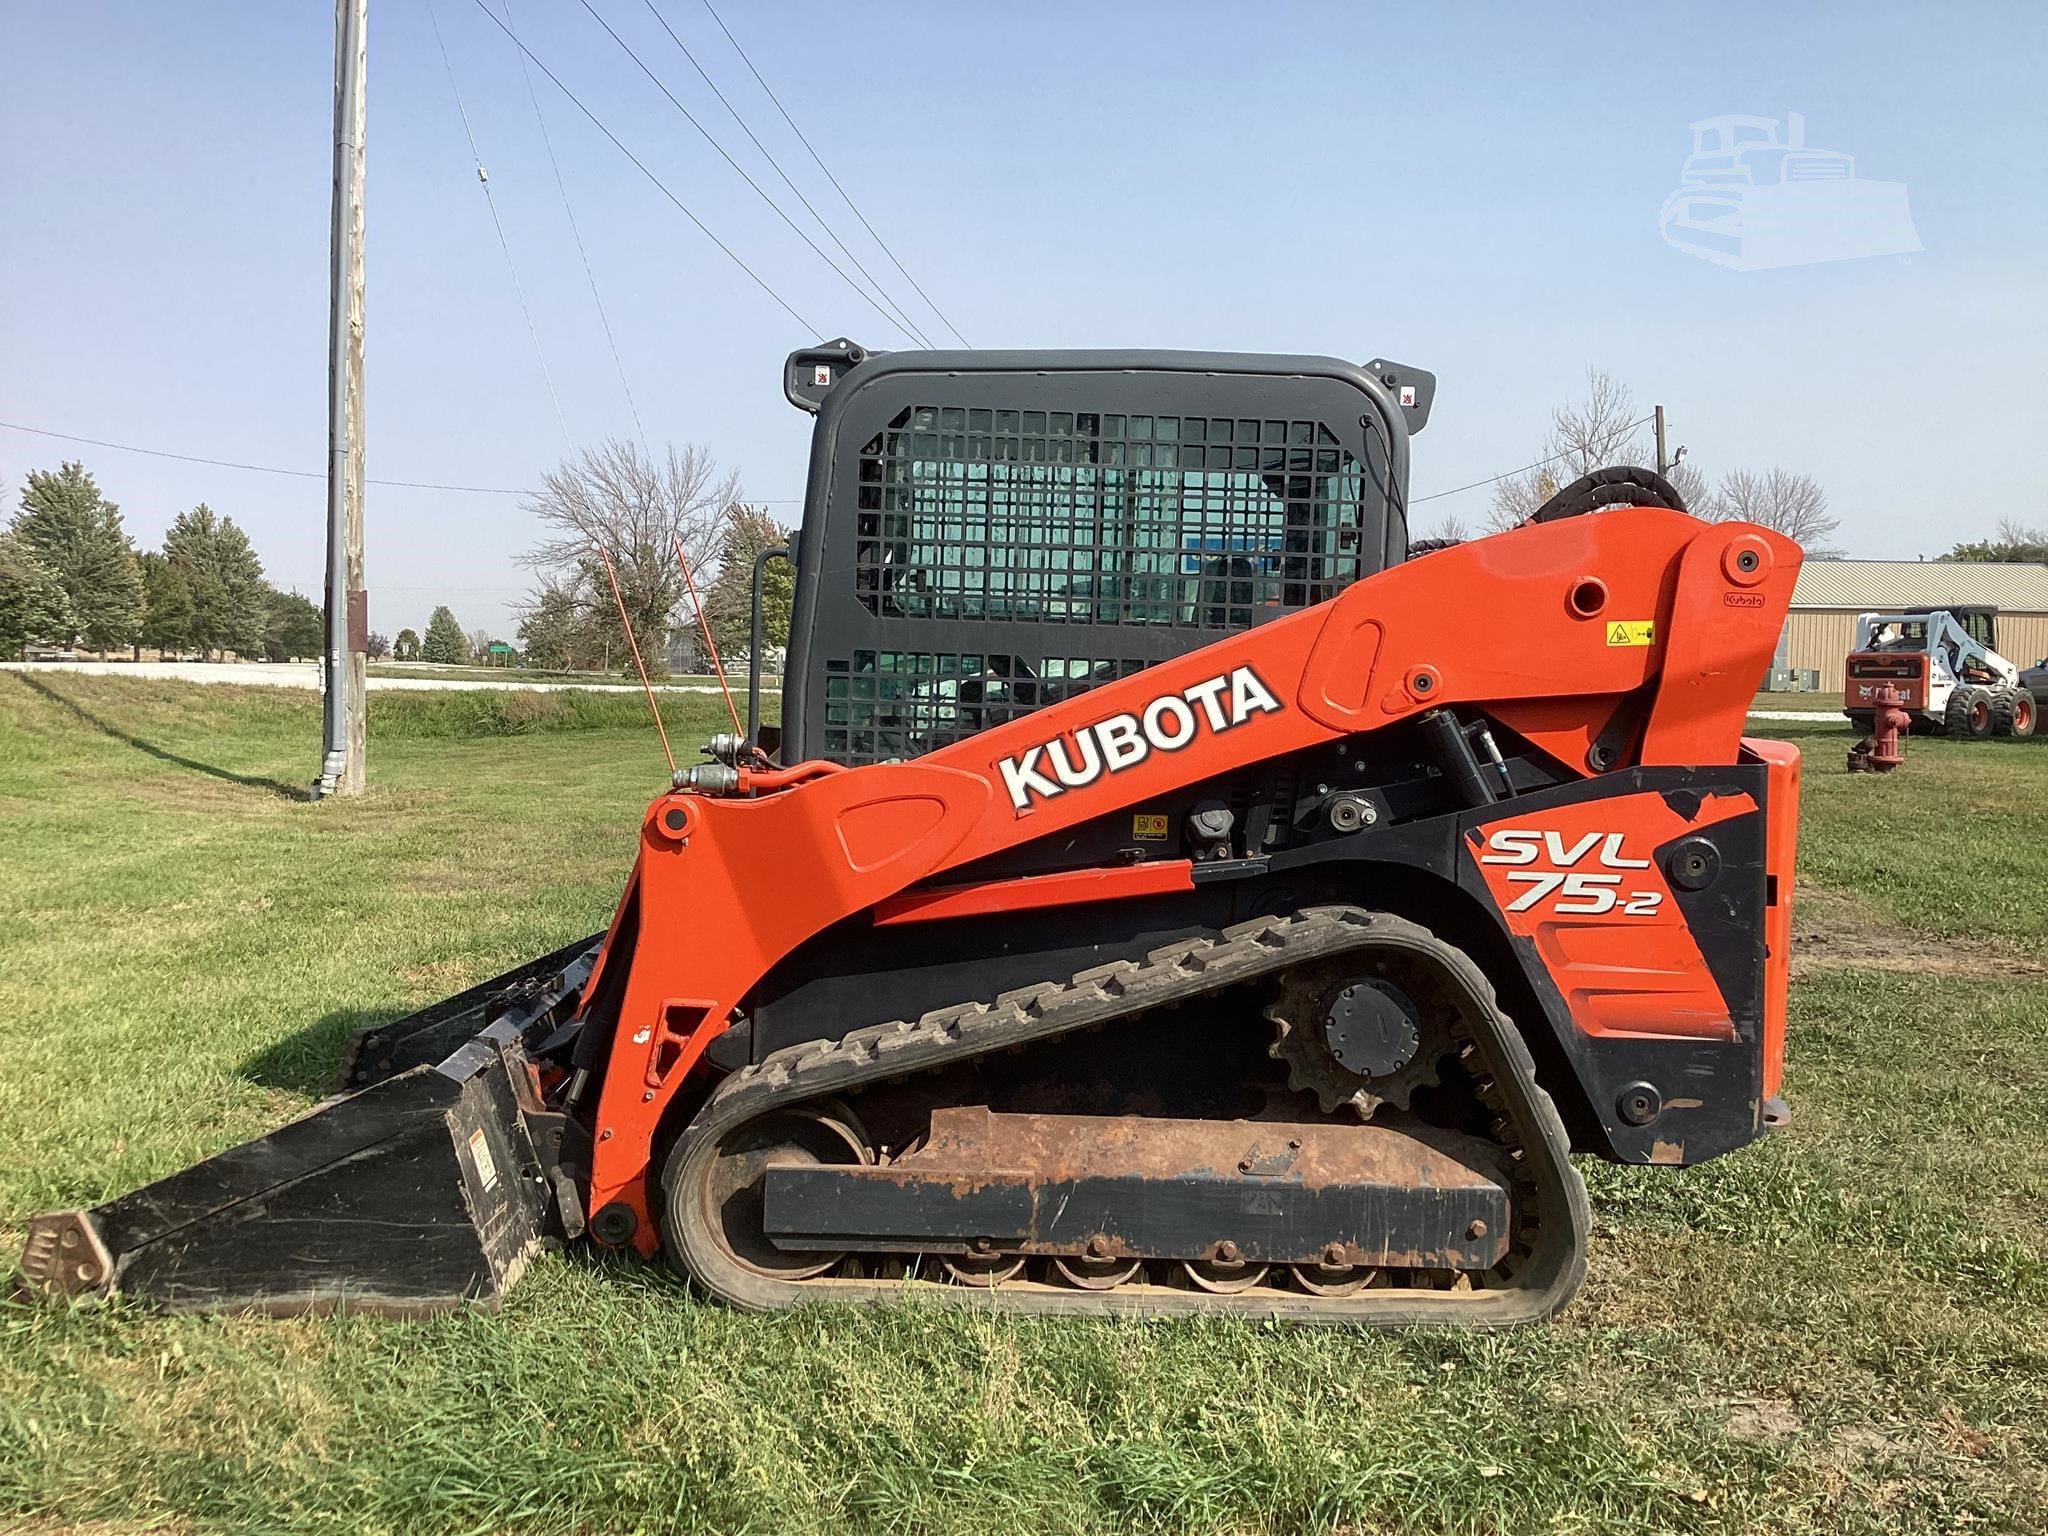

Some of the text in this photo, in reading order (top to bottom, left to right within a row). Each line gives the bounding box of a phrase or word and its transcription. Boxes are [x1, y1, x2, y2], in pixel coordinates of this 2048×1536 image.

[998, 666, 1281, 809] KUBOTA
[1481, 829, 1650, 868] SVL
[1504, 871, 1662, 916] 75-2
